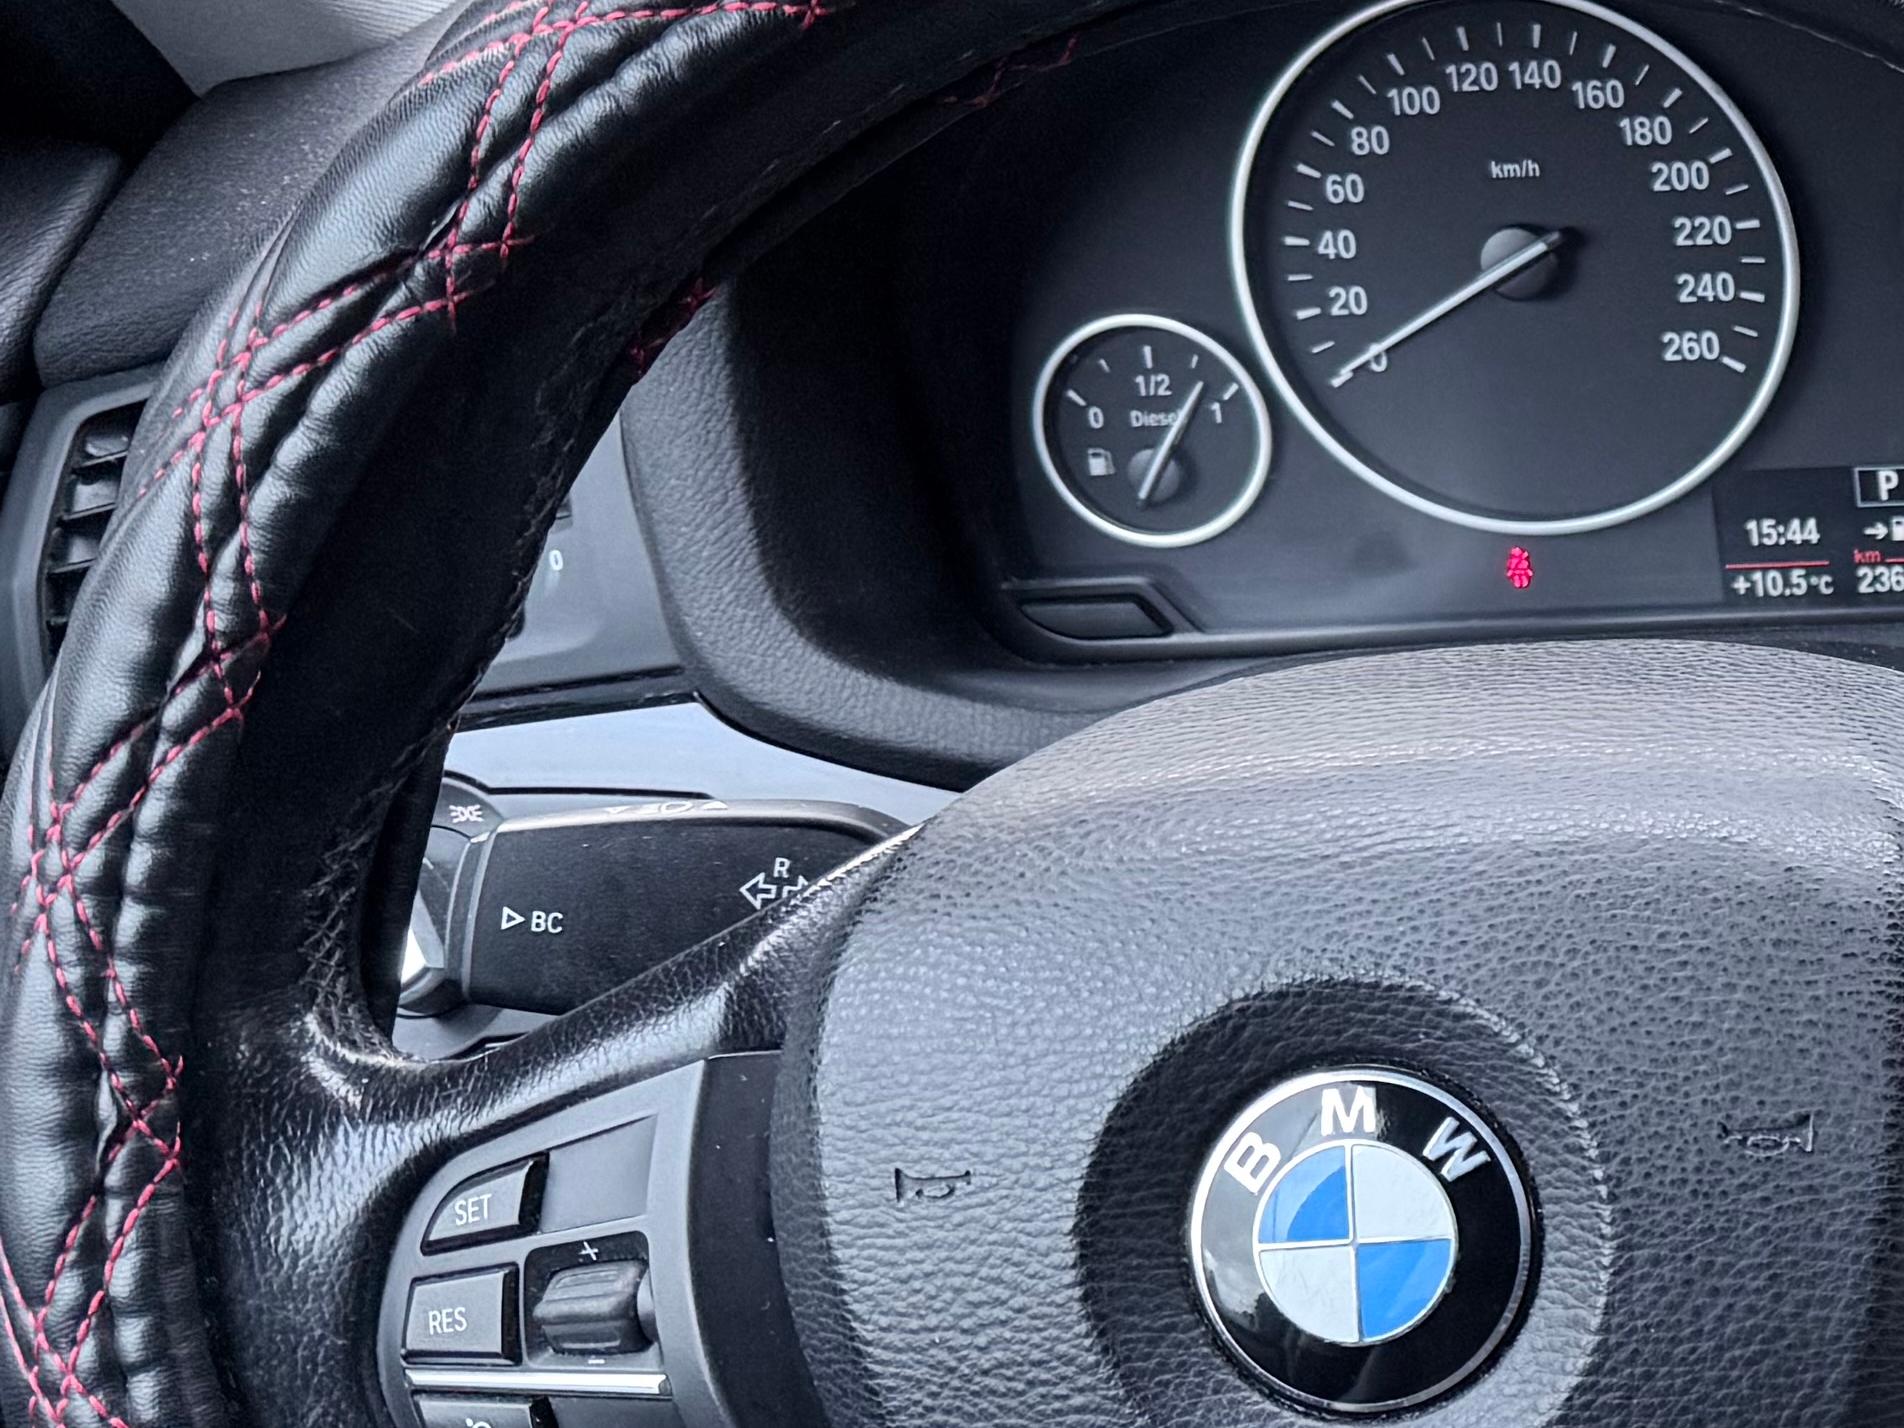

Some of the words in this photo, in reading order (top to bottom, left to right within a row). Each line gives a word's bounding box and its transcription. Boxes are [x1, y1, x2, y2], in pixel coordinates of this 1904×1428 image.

[1445, 61, 1499, 92] 120
[1508, 59, 1562, 91] 140
[1388, 85, 1441, 116] 100
[1572, 80, 1625, 110] 160
[1350, 125, 1391, 156] 80
[1619, 117, 1673, 146] 180
[1490, 159, 1541, 180] km/h
[1651, 161, 1710, 192] 200
[1325, 174, 1365, 204] 60
[1317, 230, 1357, 259] 40
[1673, 216, 1732, 246] 220
[1329, 287, 1368, 316] 20
[1677, 274, 1736, 303] 240
[1662, 331, 1721, 361] 260
[1135, 373, 1172, 397] 1/2
[1088, 408, 1104, 429] 0
[1130, 410, 1184, 428] Diese
[1210, 401, 1223, 424] 1
[1878, 470, 1899, 501] P
[1744, 517, 1821, 546] 15:44
[1853, 549, 1882, 563] km
[772, 857, 791, 879] R
[530, 910, 564, 934] BC
[1224, 1084, 1491, 1196] BMW
[454, 1193, 492, 1226] SET
[428, 1307, 468, 1335] RES
